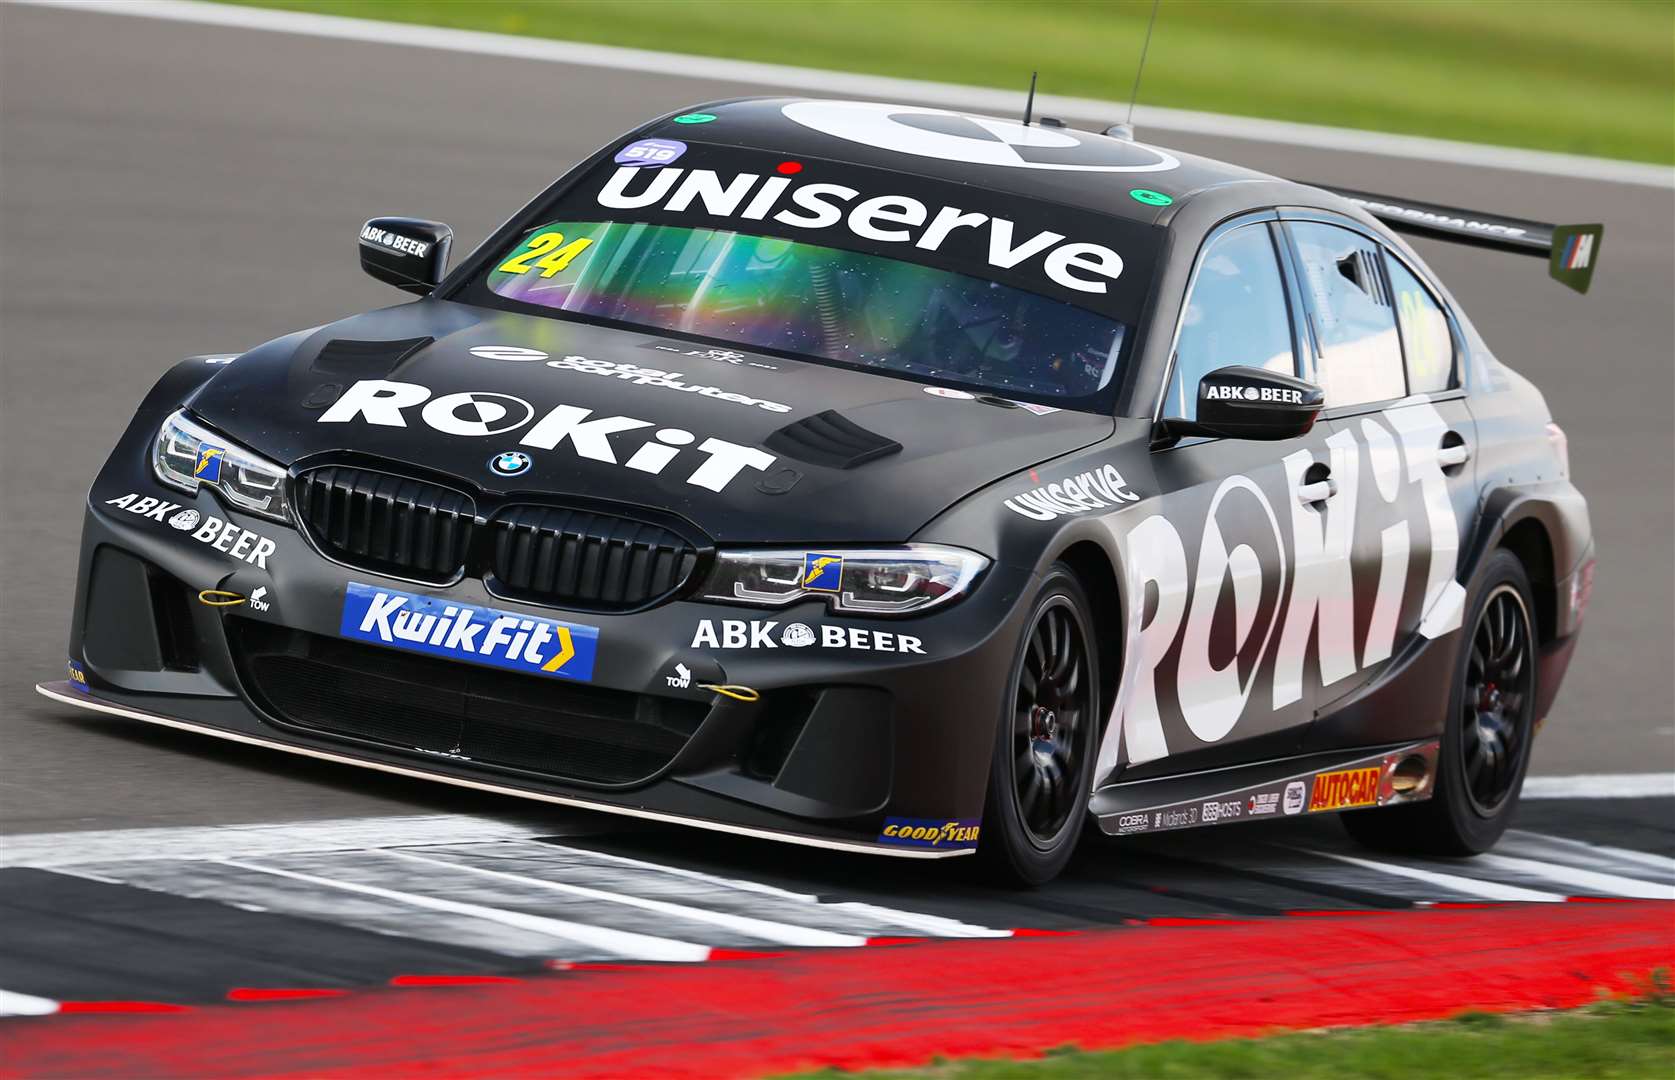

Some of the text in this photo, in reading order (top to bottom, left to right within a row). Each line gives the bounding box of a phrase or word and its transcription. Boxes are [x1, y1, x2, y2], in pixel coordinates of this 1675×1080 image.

[624, 146, 676, 160] 519
[362, 227, 427, 258] ABK BEER
[499, 233, 593, 278] 24
[562, 355, 684, 379] total
[546, 361, 792, 414] computers
[1206, 385, 1305, 405] ABK BEER
[106, 493, 276, 569] ABK BEER
[249, 598, 270, 612] TOW
[691, 619, 927, 655] ABK BEER
[666, 675, 690, 689] TOW
[1311, 770, 1379, 809] AUTOCAR
[1119, 815, 1149, 828] COBRA
